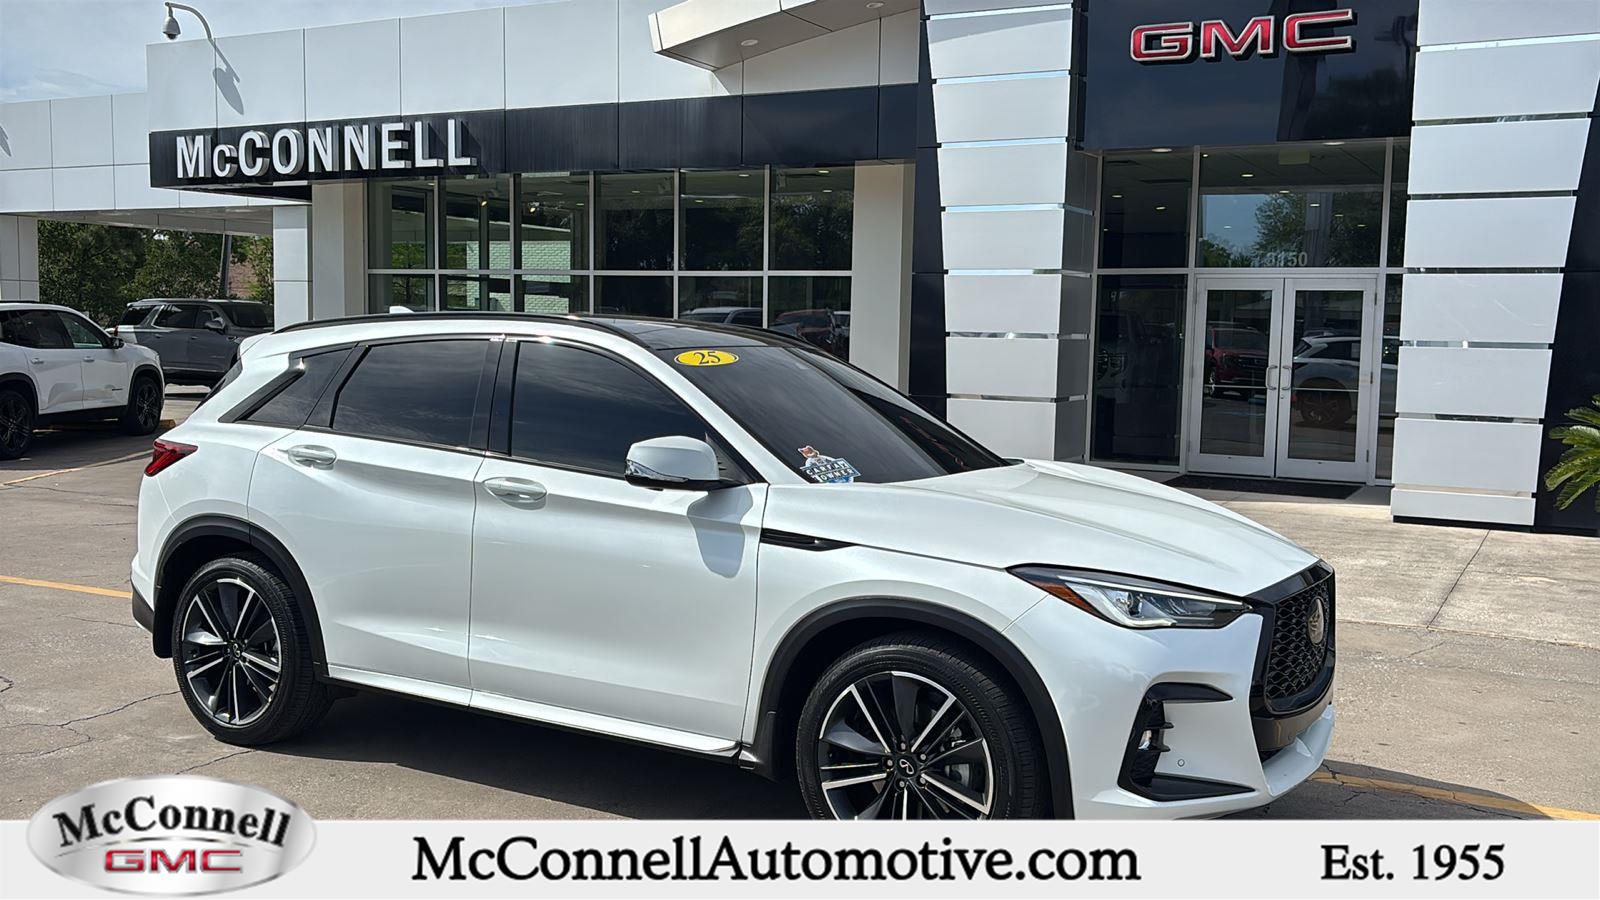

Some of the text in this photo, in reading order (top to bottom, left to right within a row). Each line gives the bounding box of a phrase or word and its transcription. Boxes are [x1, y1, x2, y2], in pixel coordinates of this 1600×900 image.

[1130, 8, 1355, 62] GMC
[176, 118, 476, 179] McCONNELL
[693, 351, 721, 365] 25
[806, 461, 849, 475] CARFAX
